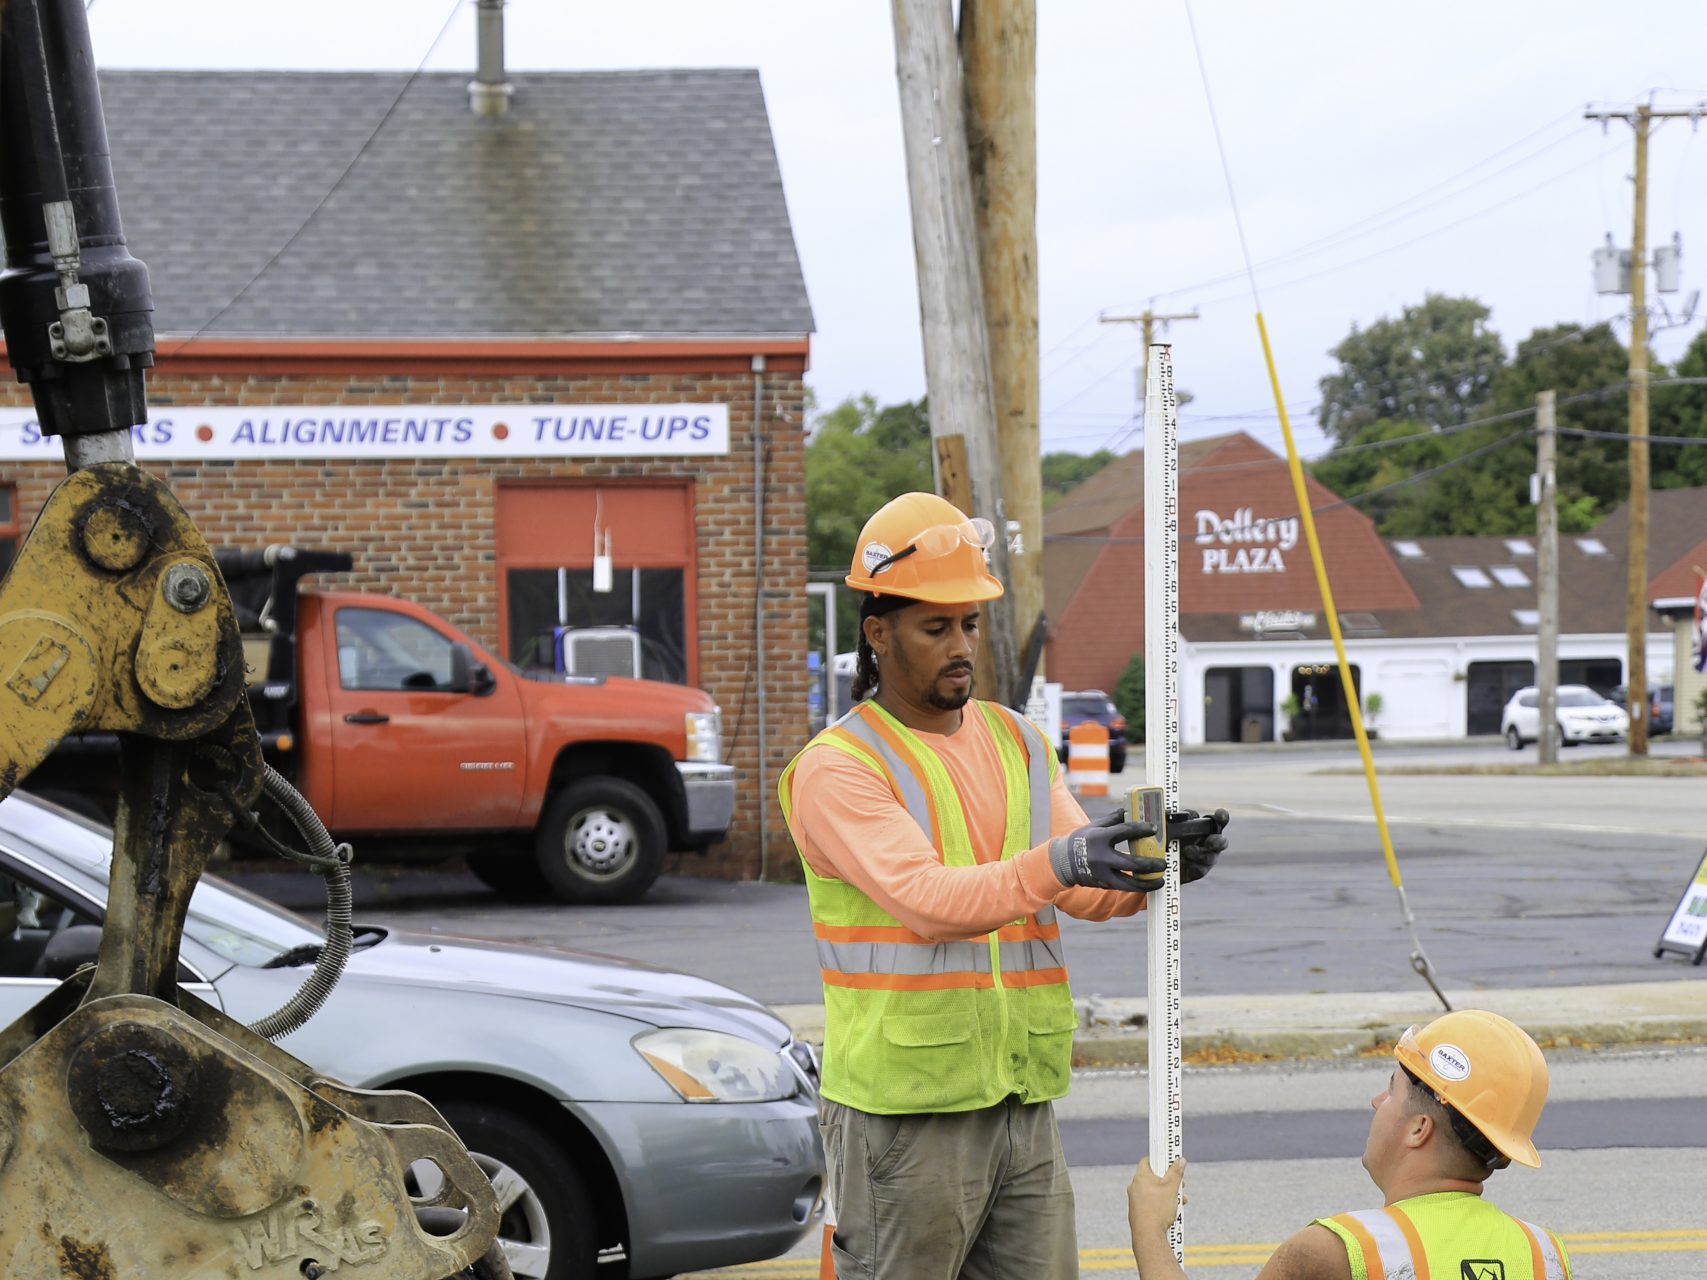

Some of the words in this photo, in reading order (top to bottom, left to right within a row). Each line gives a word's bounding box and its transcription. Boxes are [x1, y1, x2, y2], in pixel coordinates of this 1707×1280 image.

[231, 417, 473, 445] ALIGNMENTS
[531, 415, 711, 442] TUNE-UPS
[1202, 548, 1286, 574] PLAZA
[1437, 1049, 1466, 1073] BAXTER
